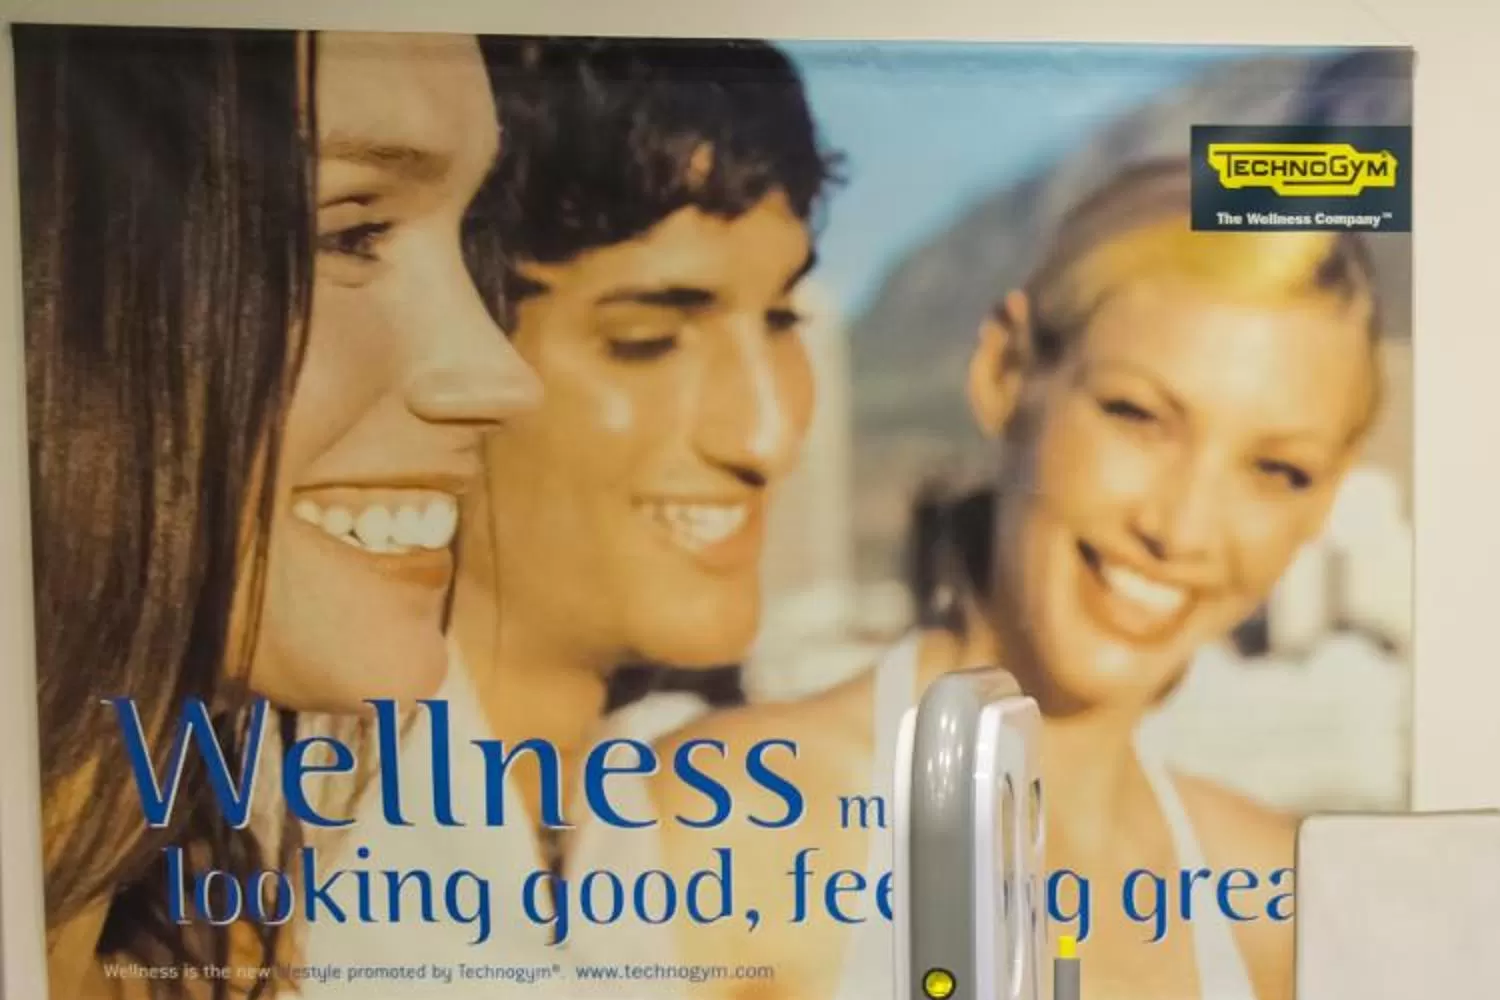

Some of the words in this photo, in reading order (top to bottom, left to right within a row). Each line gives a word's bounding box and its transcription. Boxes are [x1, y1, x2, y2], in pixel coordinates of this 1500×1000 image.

[1216, 212, 1243, 225] The
[1247, 212, 1312, 225] Wellness
[103, 696, 804, 828] Wellness
[160, 846, 490, 945] looking
[521, 847, 761, 945] good,
[103, 963, 179, 979] Wellness
[183, 963, 198, 979] is
[203, 963, 230, 979] the
[236, 966, 270, 979] new
[347, 963, 425, 983] promoted
[431, 963, 452, 984] by
[576, 963, 775, 983] www.technogym.com
